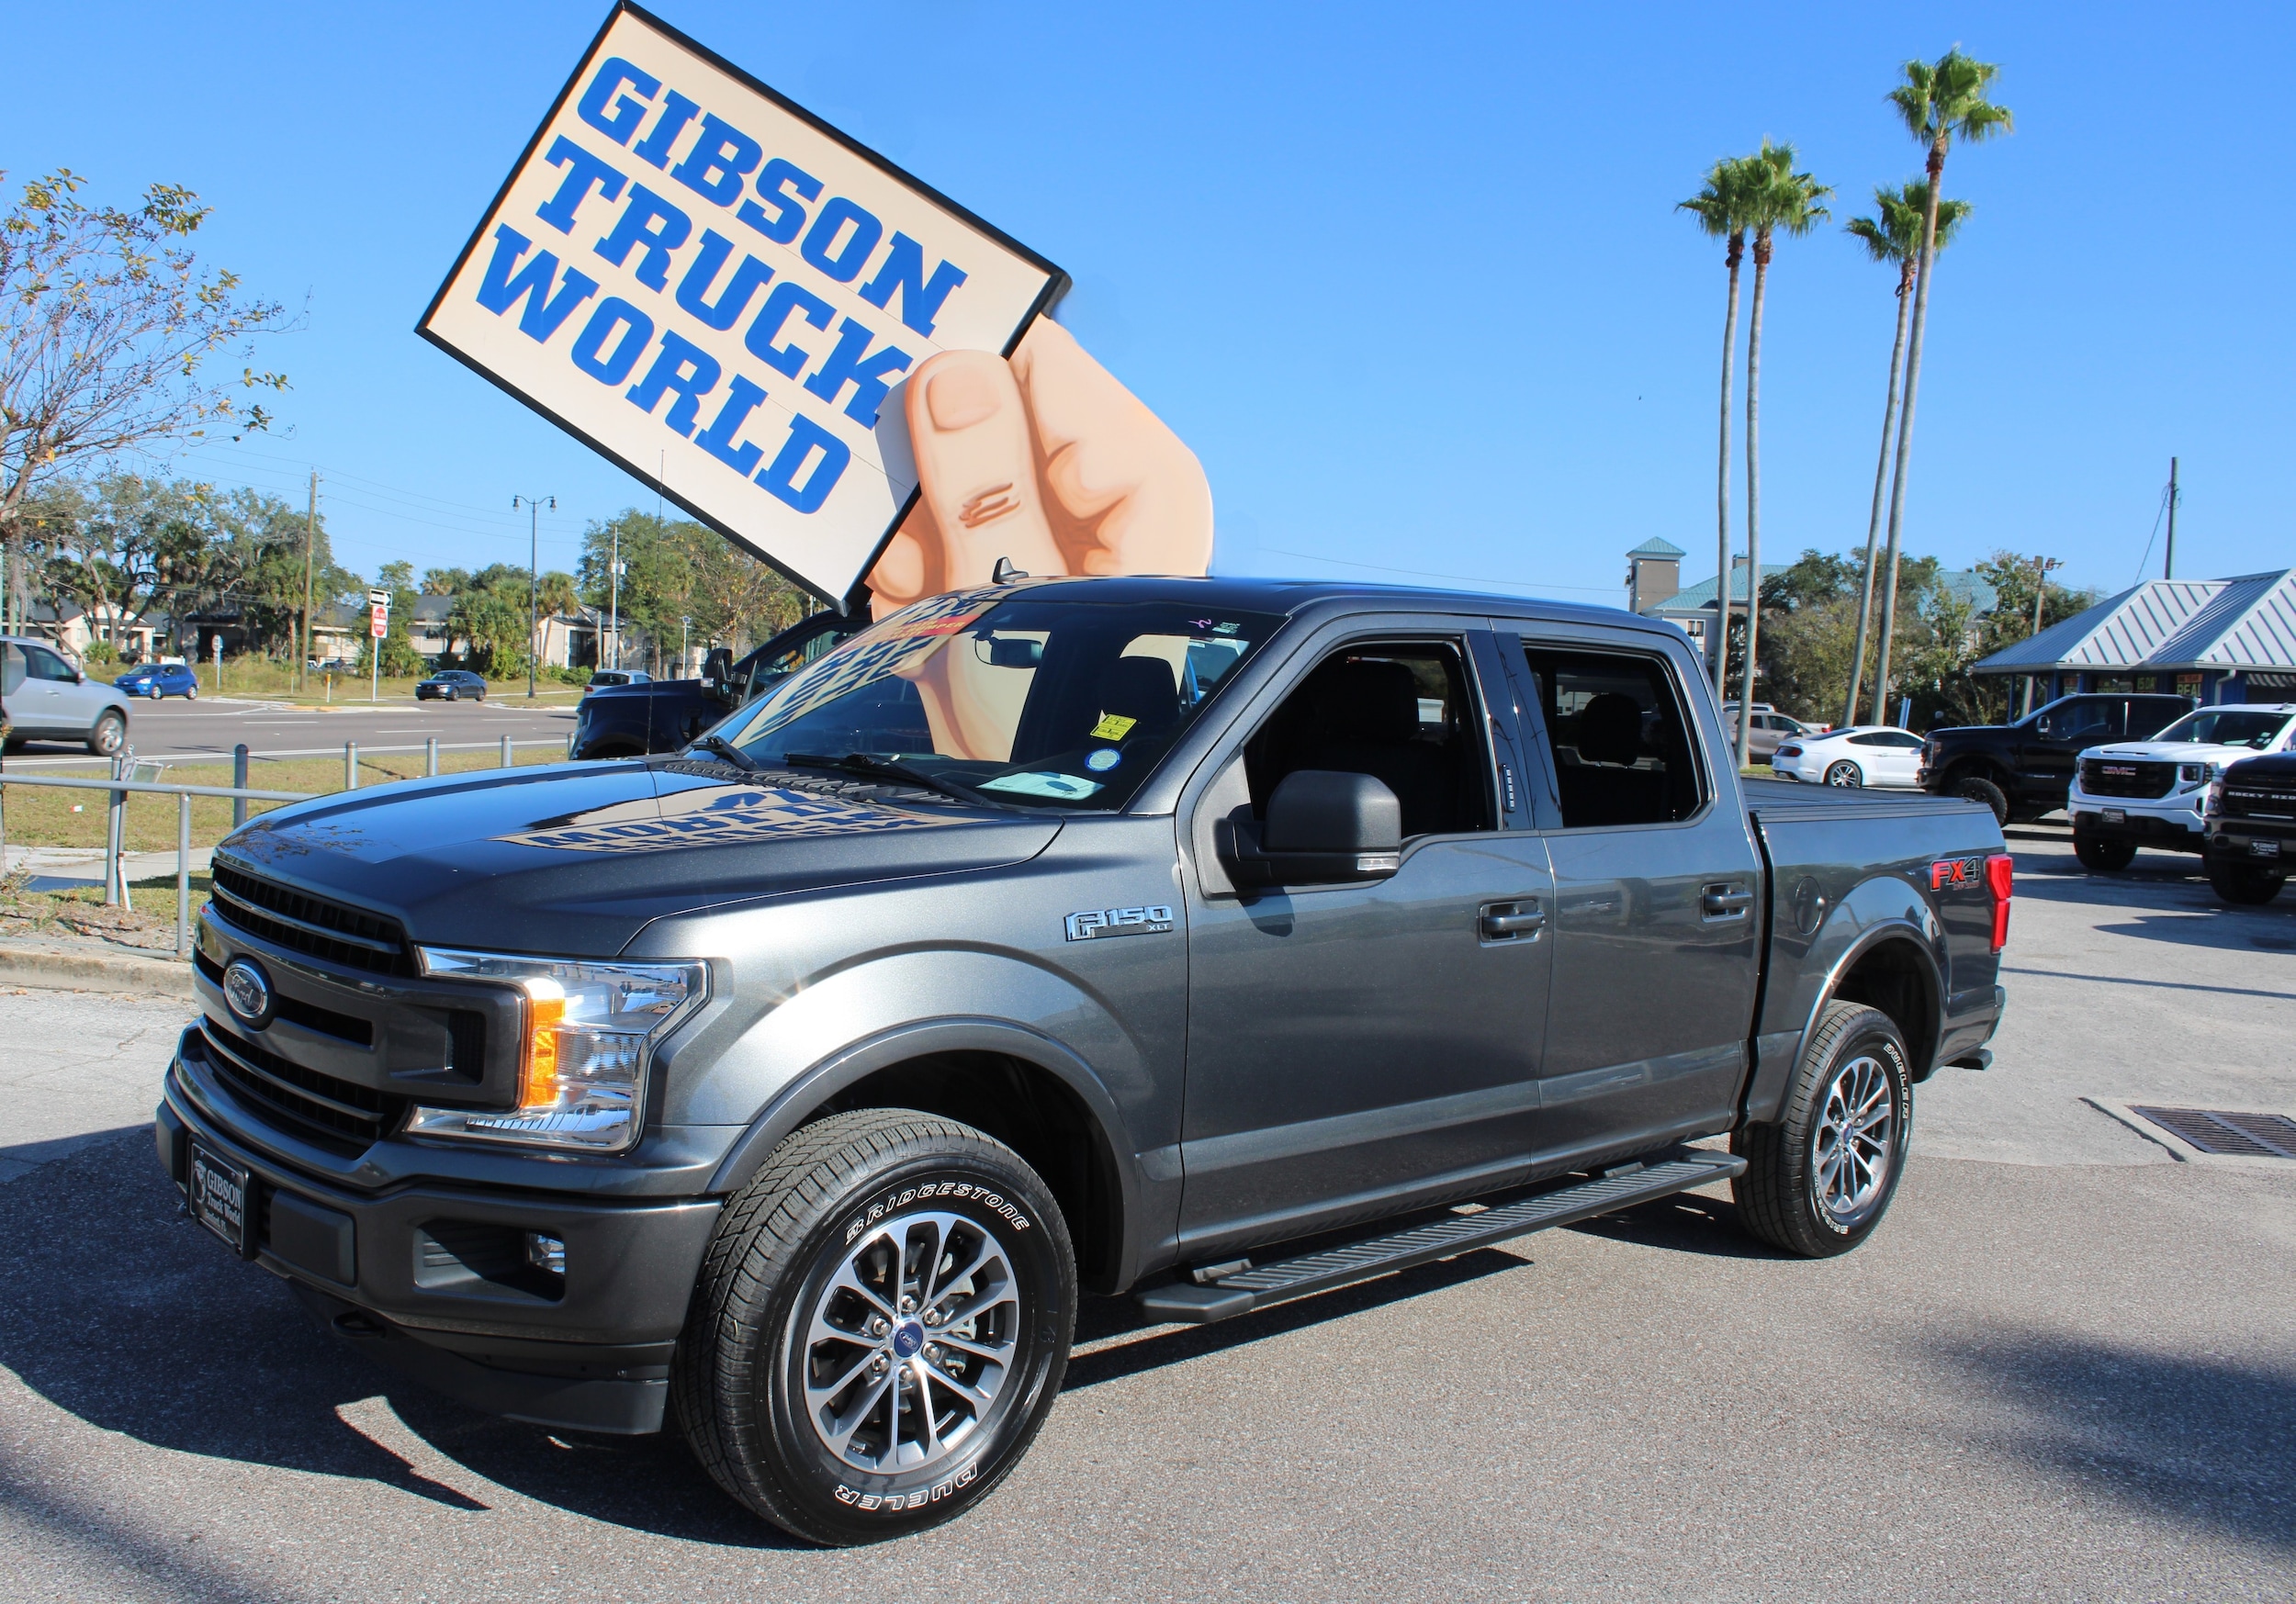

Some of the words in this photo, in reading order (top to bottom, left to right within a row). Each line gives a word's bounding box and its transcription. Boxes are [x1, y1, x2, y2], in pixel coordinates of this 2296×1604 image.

[577, 57, 968, 338] GIBSON
[535, 134, 915, 430] TRUCK
[475, 223, 851, 515] WORLD
[2101, 765, 2136, 776] GMC
[1930, 856, 1981, 892] FX4
[1148, 923, 1170, 932] XLT
[229, 973, 253, 1006] Ford
[1883, 1042, 1910, 1119] DUELER
[206, 1169, 242, 1210] GIBSON
[207, 1192, 223, 1215] Truck
[224, 1202, 241, 1227] World
[845, 1181, 1030, 1246] BRIDGESTONE
[834, 1461, 978, 1511] DUELER
